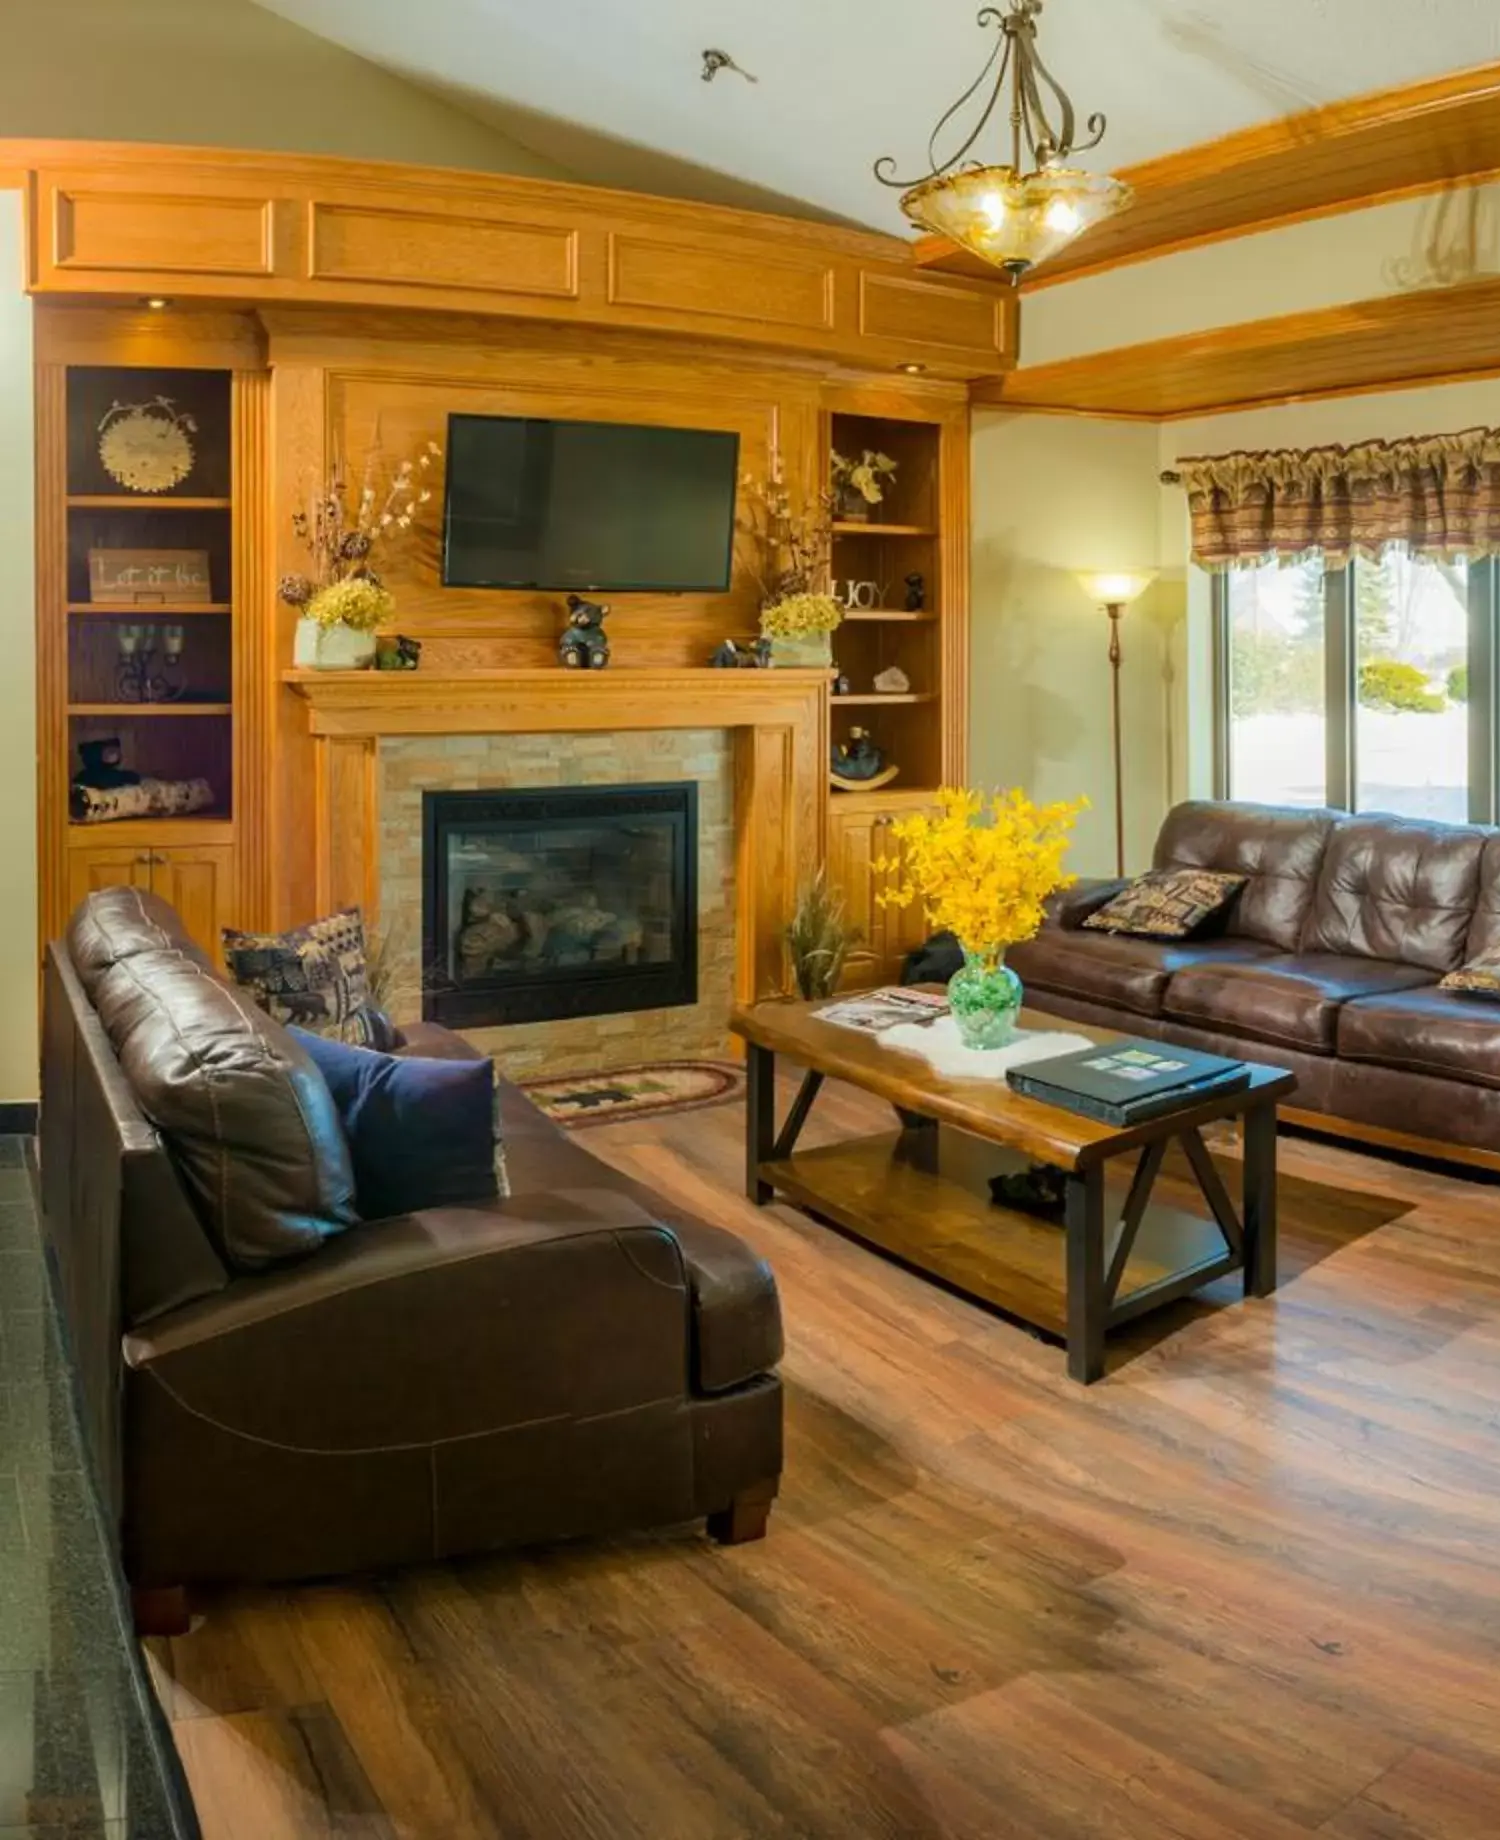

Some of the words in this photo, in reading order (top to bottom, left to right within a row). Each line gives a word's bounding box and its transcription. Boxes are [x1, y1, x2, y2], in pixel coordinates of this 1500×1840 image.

[98, 557, 143, 589] Let
[148, 565, 172, 586] it
[844, 580, 891, 609] JOY
